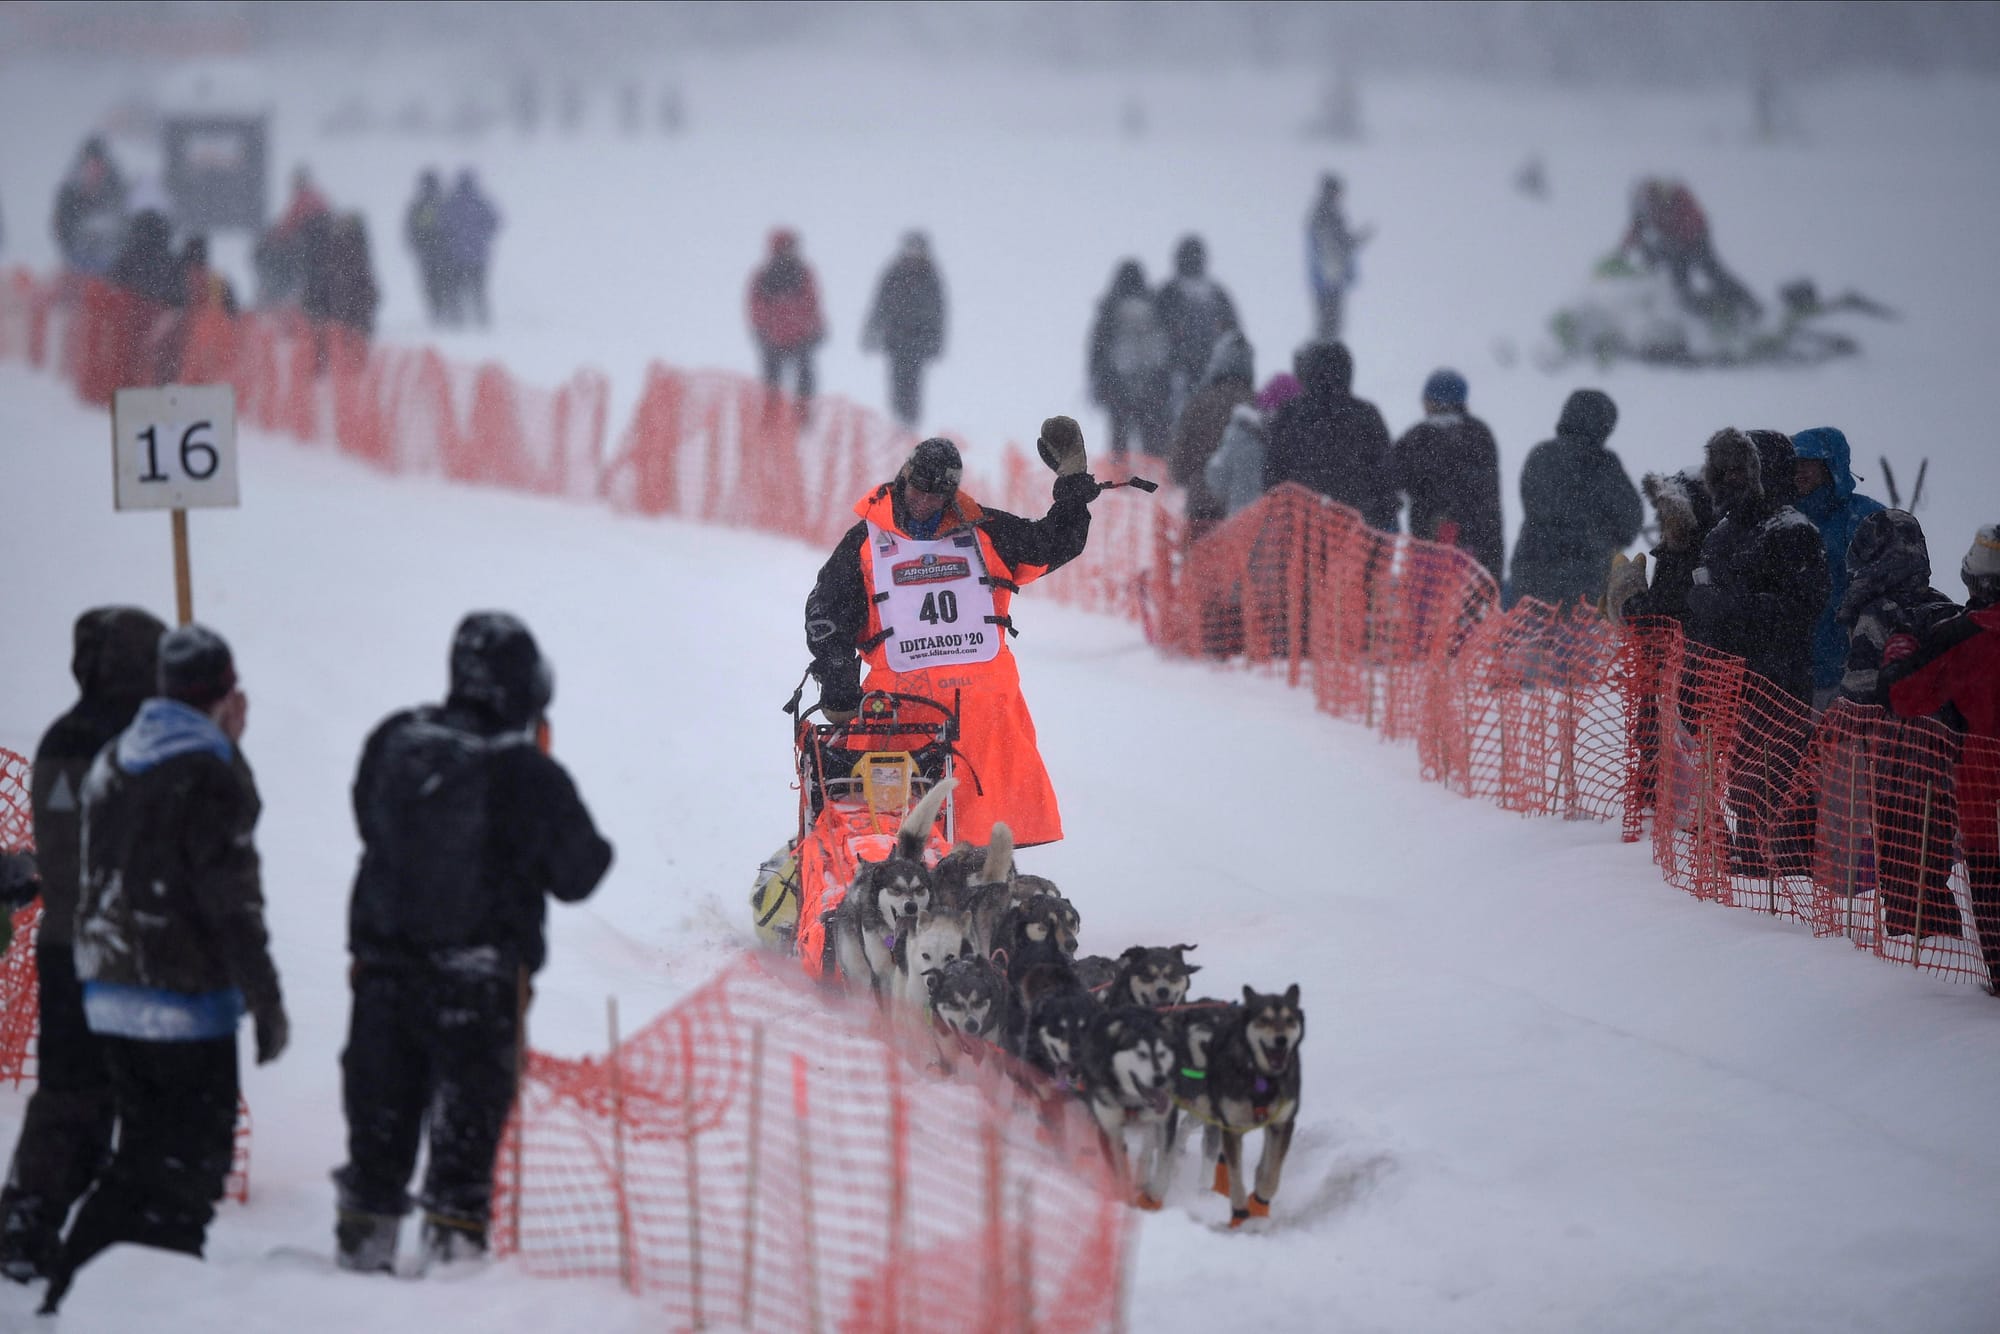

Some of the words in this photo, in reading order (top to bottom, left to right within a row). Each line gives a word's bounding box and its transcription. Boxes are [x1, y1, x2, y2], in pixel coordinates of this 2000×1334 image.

[136, 420, 219, 483] 16
[904, 563, 959, 577] ANCHORAGE
[919, 590, 958, 625] 40
[899, 634, 962, 654] IDITAROD
[965, 632, 984, 646] '20
[909, 647, 978, 661] www.iditarod.com
